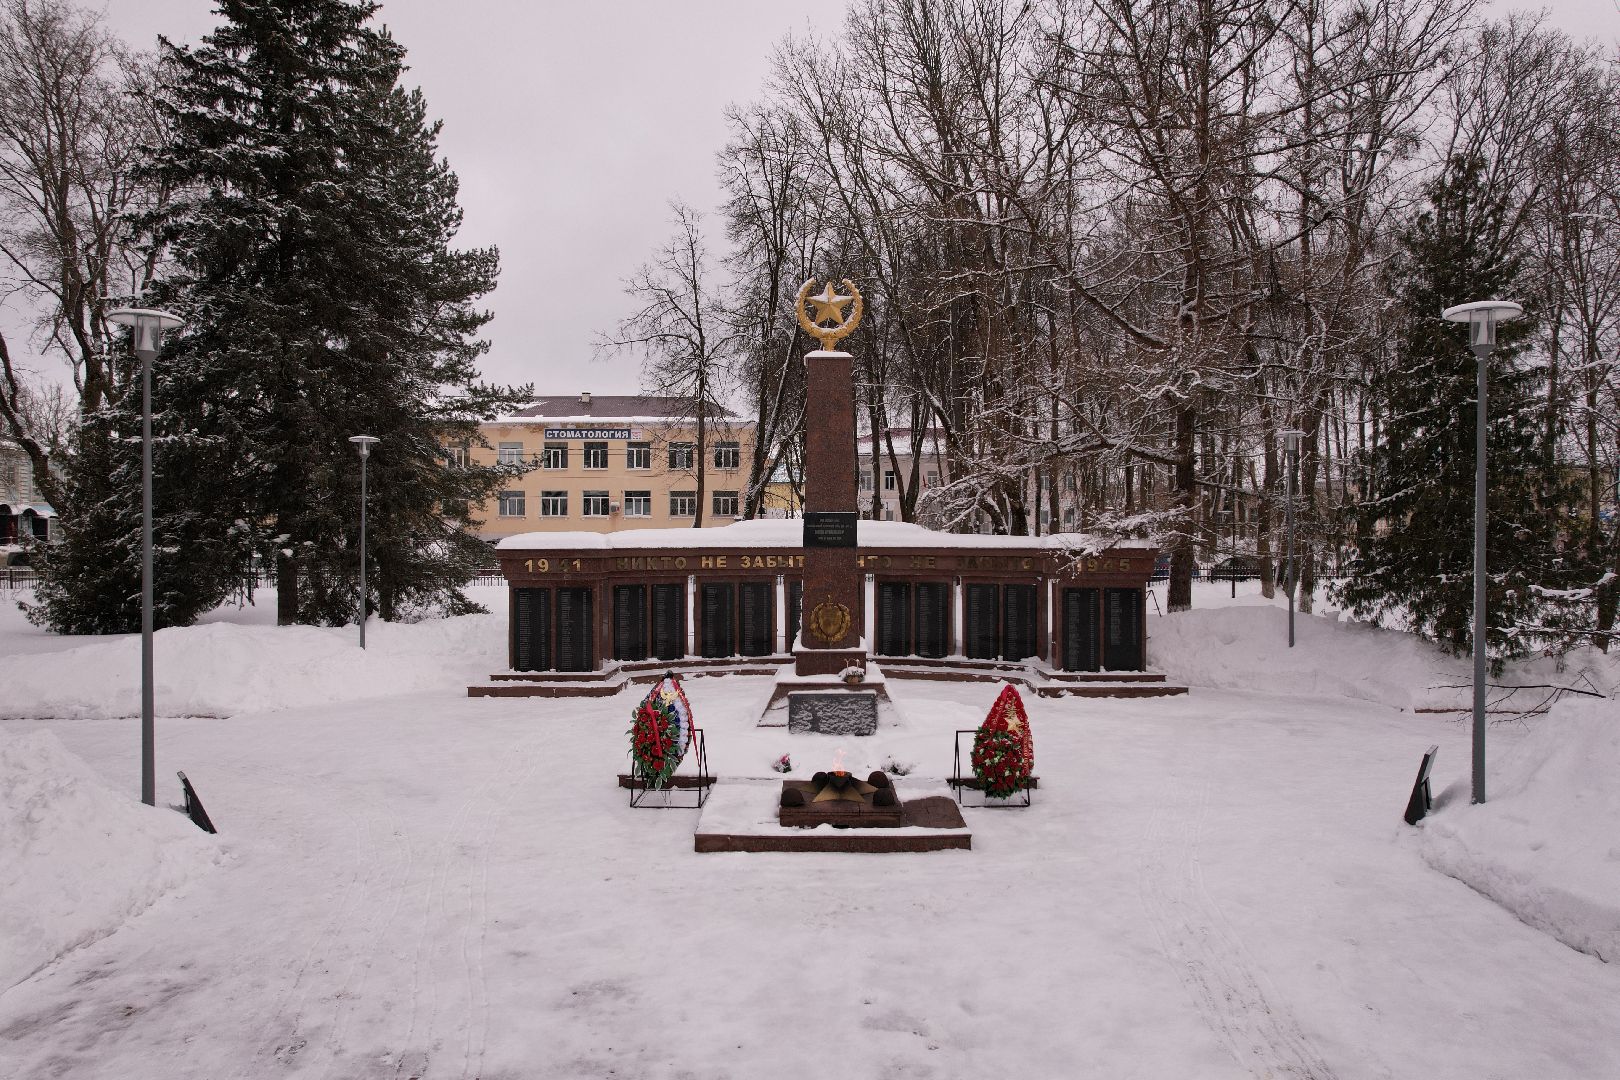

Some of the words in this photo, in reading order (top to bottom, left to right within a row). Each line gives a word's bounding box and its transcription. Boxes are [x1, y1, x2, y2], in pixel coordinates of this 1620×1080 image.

[546, 430, 629, 439] СТОМАТОЛОГИЯ
[524, 558, 581, 572] 1941
[616, 556, 687, 570] НИКТО
[701, 555, 728, 568] НЕ
[910, 555, 936, 568] НЕ
